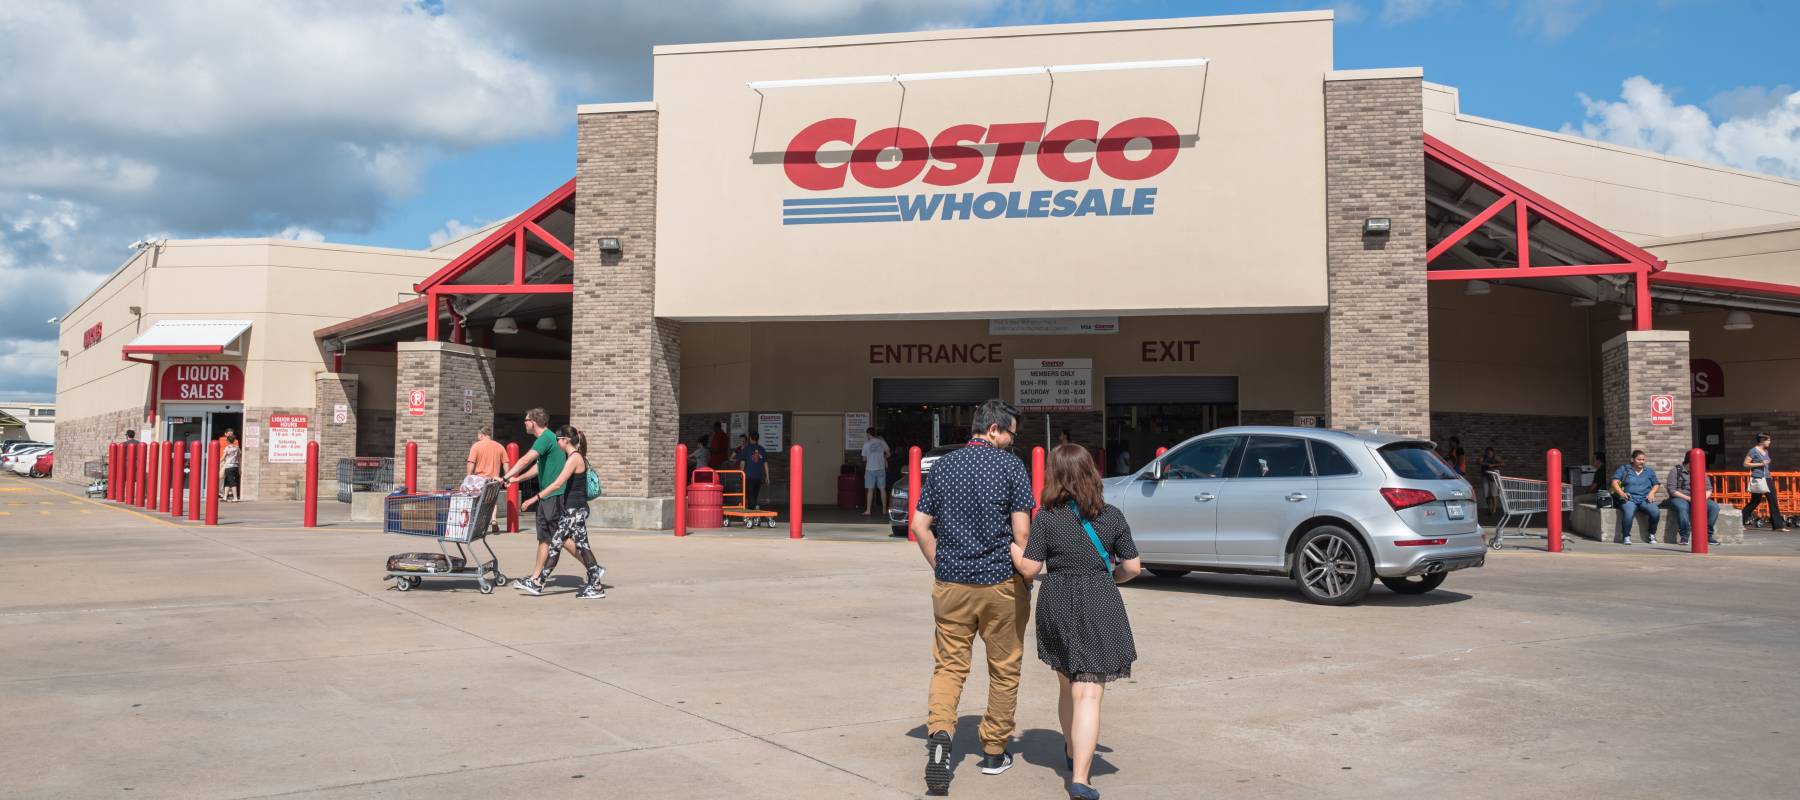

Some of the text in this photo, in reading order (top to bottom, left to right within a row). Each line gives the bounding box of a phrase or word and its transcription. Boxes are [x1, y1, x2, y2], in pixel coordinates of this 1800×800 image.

[783, 117, 1181, 191] COSTCO
[899, 187, 1158, 222] WHOLESALE
[869, 343, 1003, 364] ENTRANCE
[1142, 340, 1201, 362] EXIT
[177, 365, 230, 382] LIQUOR
[180, 383, 224, 399] SALES
